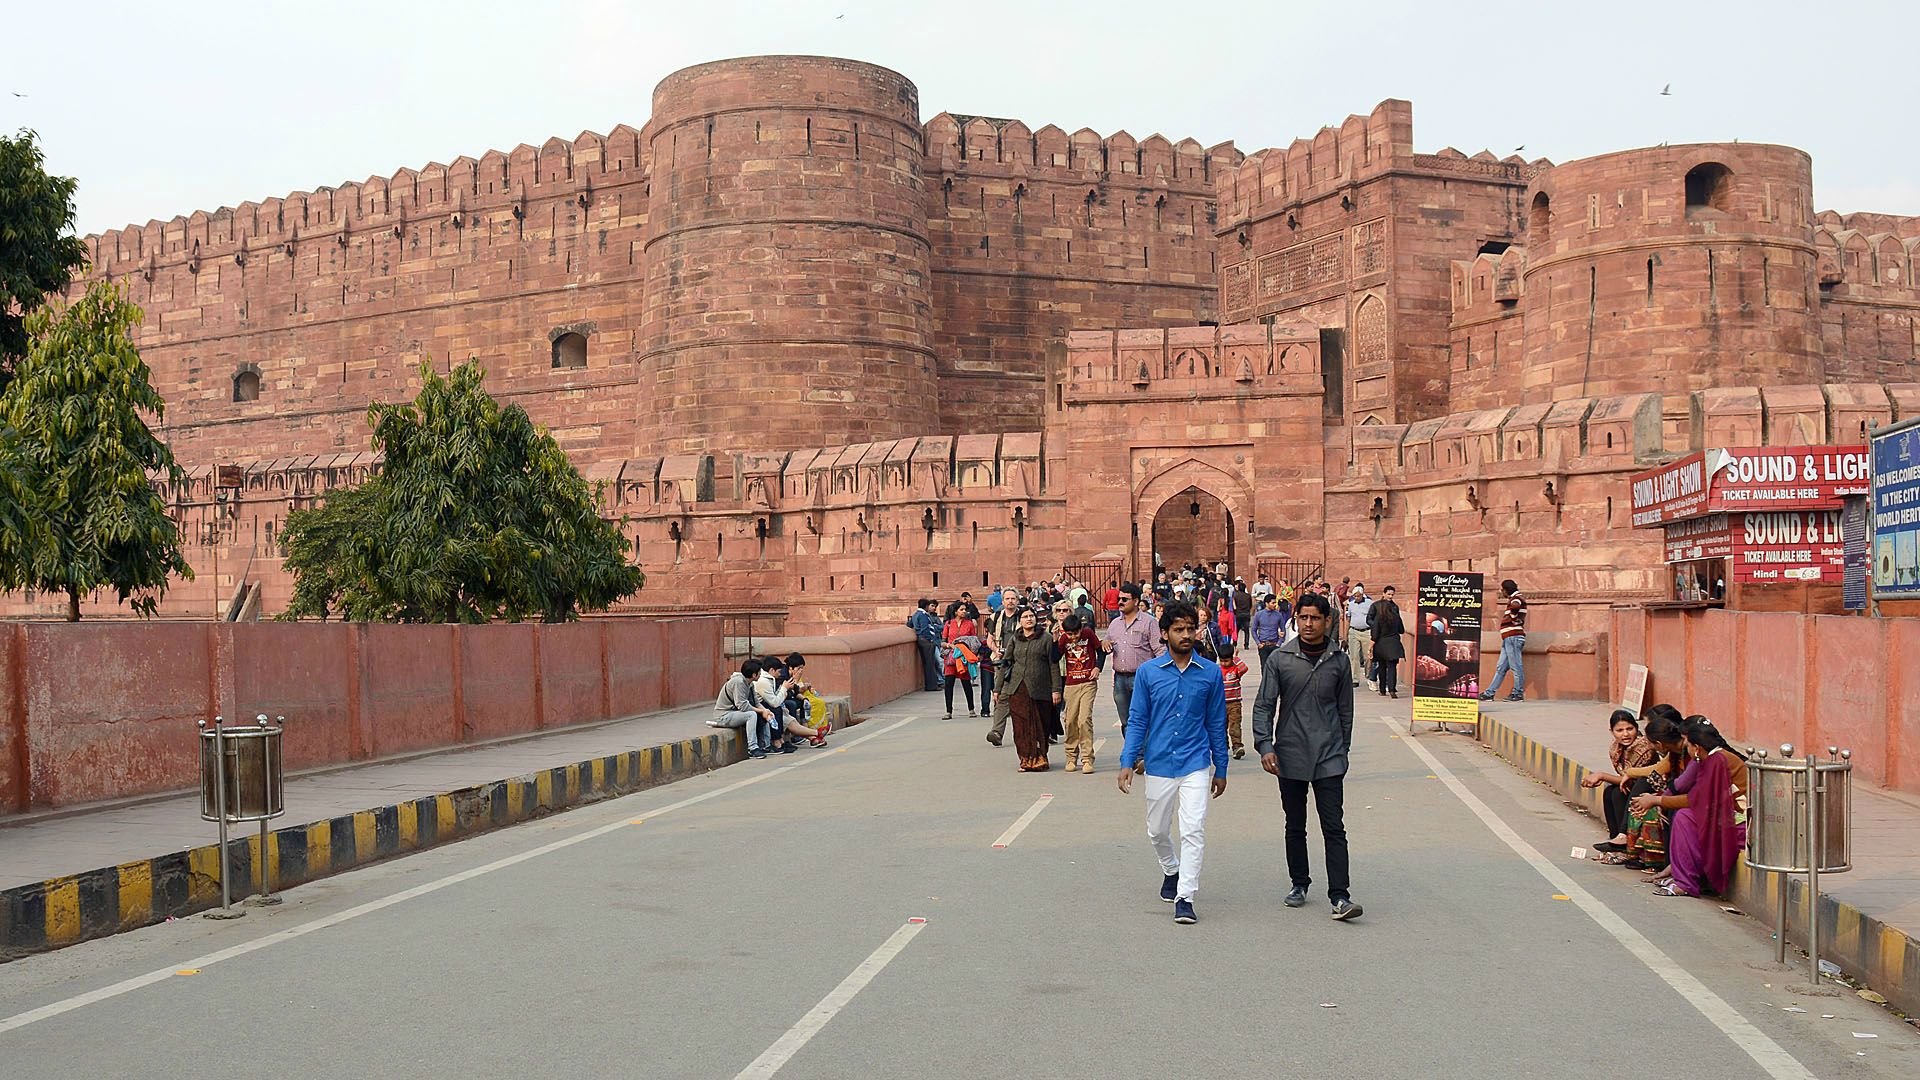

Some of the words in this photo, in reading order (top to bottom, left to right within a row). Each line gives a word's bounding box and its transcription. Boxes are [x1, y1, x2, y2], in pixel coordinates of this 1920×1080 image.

[1726, 456, 1796, 483] SOUND
[1803, 454, 1818, 481] &
[1824, 453, 1870, 481] LIGH
[1876, 473, 1886, 488] ASI
[1886, 466, 1920, 485] WELCOMES
[1633, 479, 1654, 508] SOUND
[1654, 476, 1660, 503] &
[1660, 469, 1679, 501] LIGHT
[1680, 460, 1701, 496] SHOW
[1722, 490, 1750, 501] TICKET
[1752, 488, 1795, 500] AVAILABLE
[1797, 487, 1819, 498] HERE
[1881, 492, 1889, 507] IN
[1889, 490, 1903, 506] THE
[1903, 486, 1920, 503] CITY
[1744, 512, 1802, 545] SOUND
[1806, 512, 1819, 543] &
[1877, 510, 1900, 528] WORLD
[1744, 551, 1763, 563] TICKET
[1765, 551, 1795, 562] AVAILABLE
[1796, 550, 1812, 562] HERE
[1753, 570, 1778, 579] Hindi
[1418, 597, 1439, 607] Sound
[1439, 598, 1446, 607] &
[1445, 598, 1464, 610] Light
[1464, 599, 1482, 609] Show
